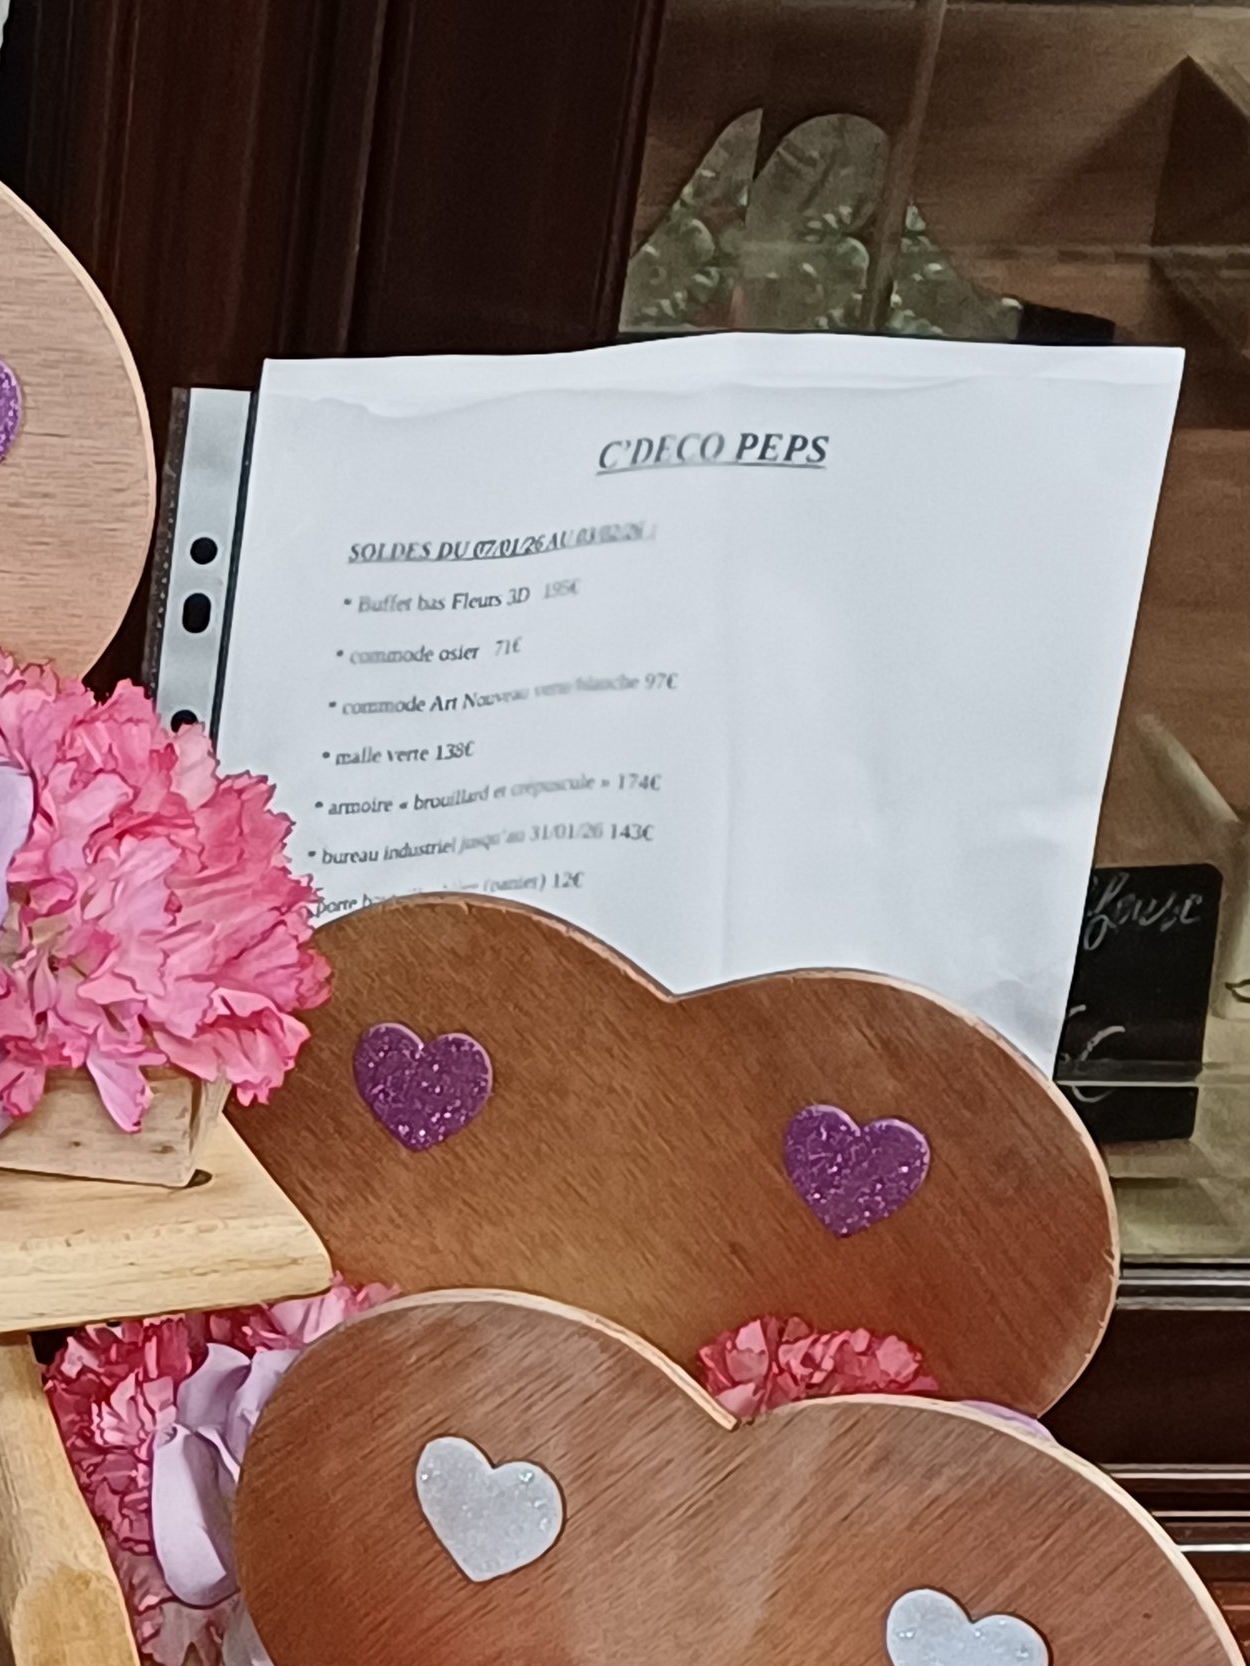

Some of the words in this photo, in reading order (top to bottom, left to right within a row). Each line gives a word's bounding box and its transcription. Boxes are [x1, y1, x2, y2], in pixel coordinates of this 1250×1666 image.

[735, 431, 830, 465] PEPS
[347, 541, 432, 563] SOLDES
[436, 540, 471, 561] DU
[547, 530, 574, 553] AU
[358, 594, 411, 613] Buffet
[417, 594, 446, 611] bas
[451, 592, 502, 611] Fleurs
[506, 587, 531, 607] 3D
[350, 646, 434, 665] commode
[439, 644, 480, 662] osier
[495, 637, 523, 657] 71€
[342, 696, 426, 715] commode
[430, 694, 458, 713] Art
[462, 686, 530, 710] Nouveau
[644, 672, 679, 690] 97€
[335, 747, 382, 765] malle
[387, 748, 430, 763] verte
[435, 741, 474, 761] 138€
[328, 799, 394, 816] armoire
[413, 785, 490, 811] brouillard
[493, 784, 508, 800] et
[510, 775, 596, 799] crépuscule
[617, 773, 662, 793] 174€
[321, 847, 379, 865] bureau
[383, 837, 456, 862] industriel
[610, 822, 655, 842] 143€
[315, 897, 358, 918] porte
[553, 870, 586, 889] 12€
